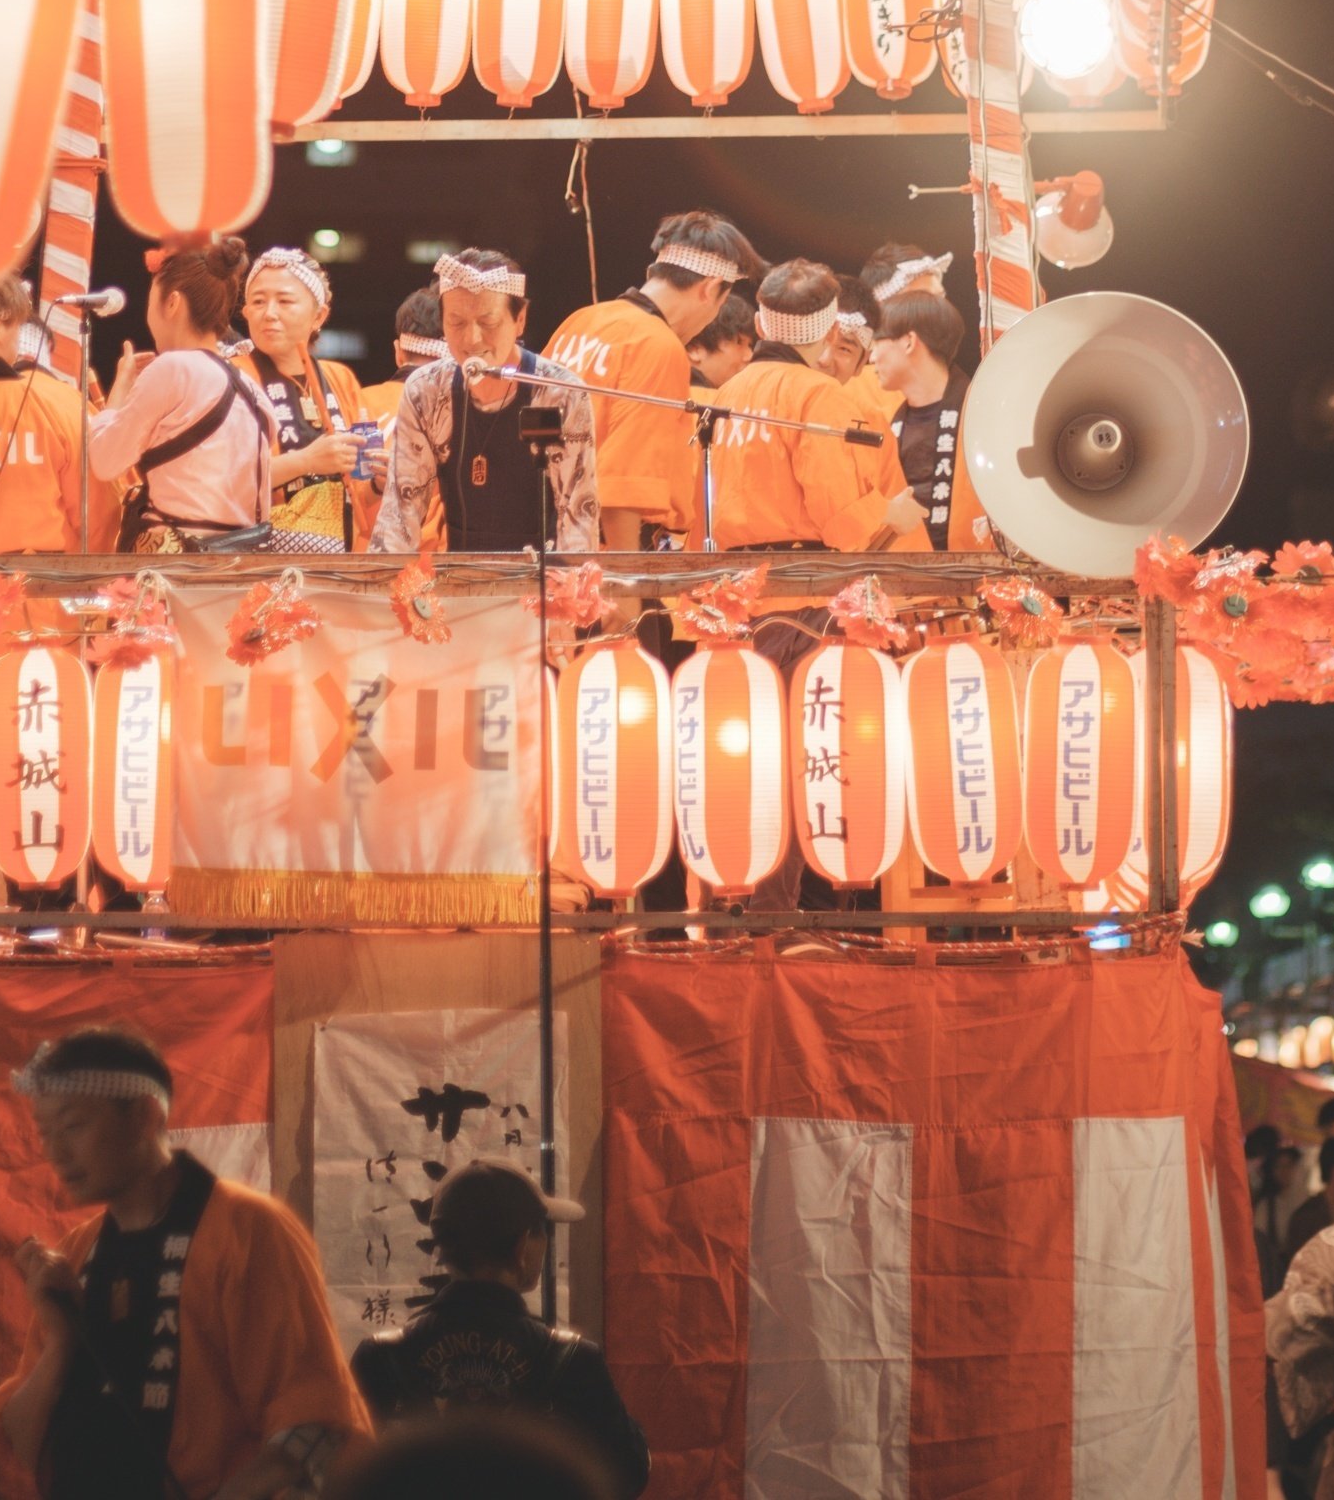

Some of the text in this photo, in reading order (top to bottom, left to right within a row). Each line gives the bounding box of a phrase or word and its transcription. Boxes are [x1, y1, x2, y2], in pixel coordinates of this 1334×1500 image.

[715, 405, 771, 448] IXIL
[6, 679, 67, 853] 赤城山
[117, 685, 153, 860] アサヒビール
[581, 686, 613, 863] アサヒビール
[676, 685, 705, 862] アサヒビール
[797, 675, 851, 843] 赤城山
[949, 676, 993, 855] アサヒビール
[1058, 680, 1096, 858] アサヒビール
